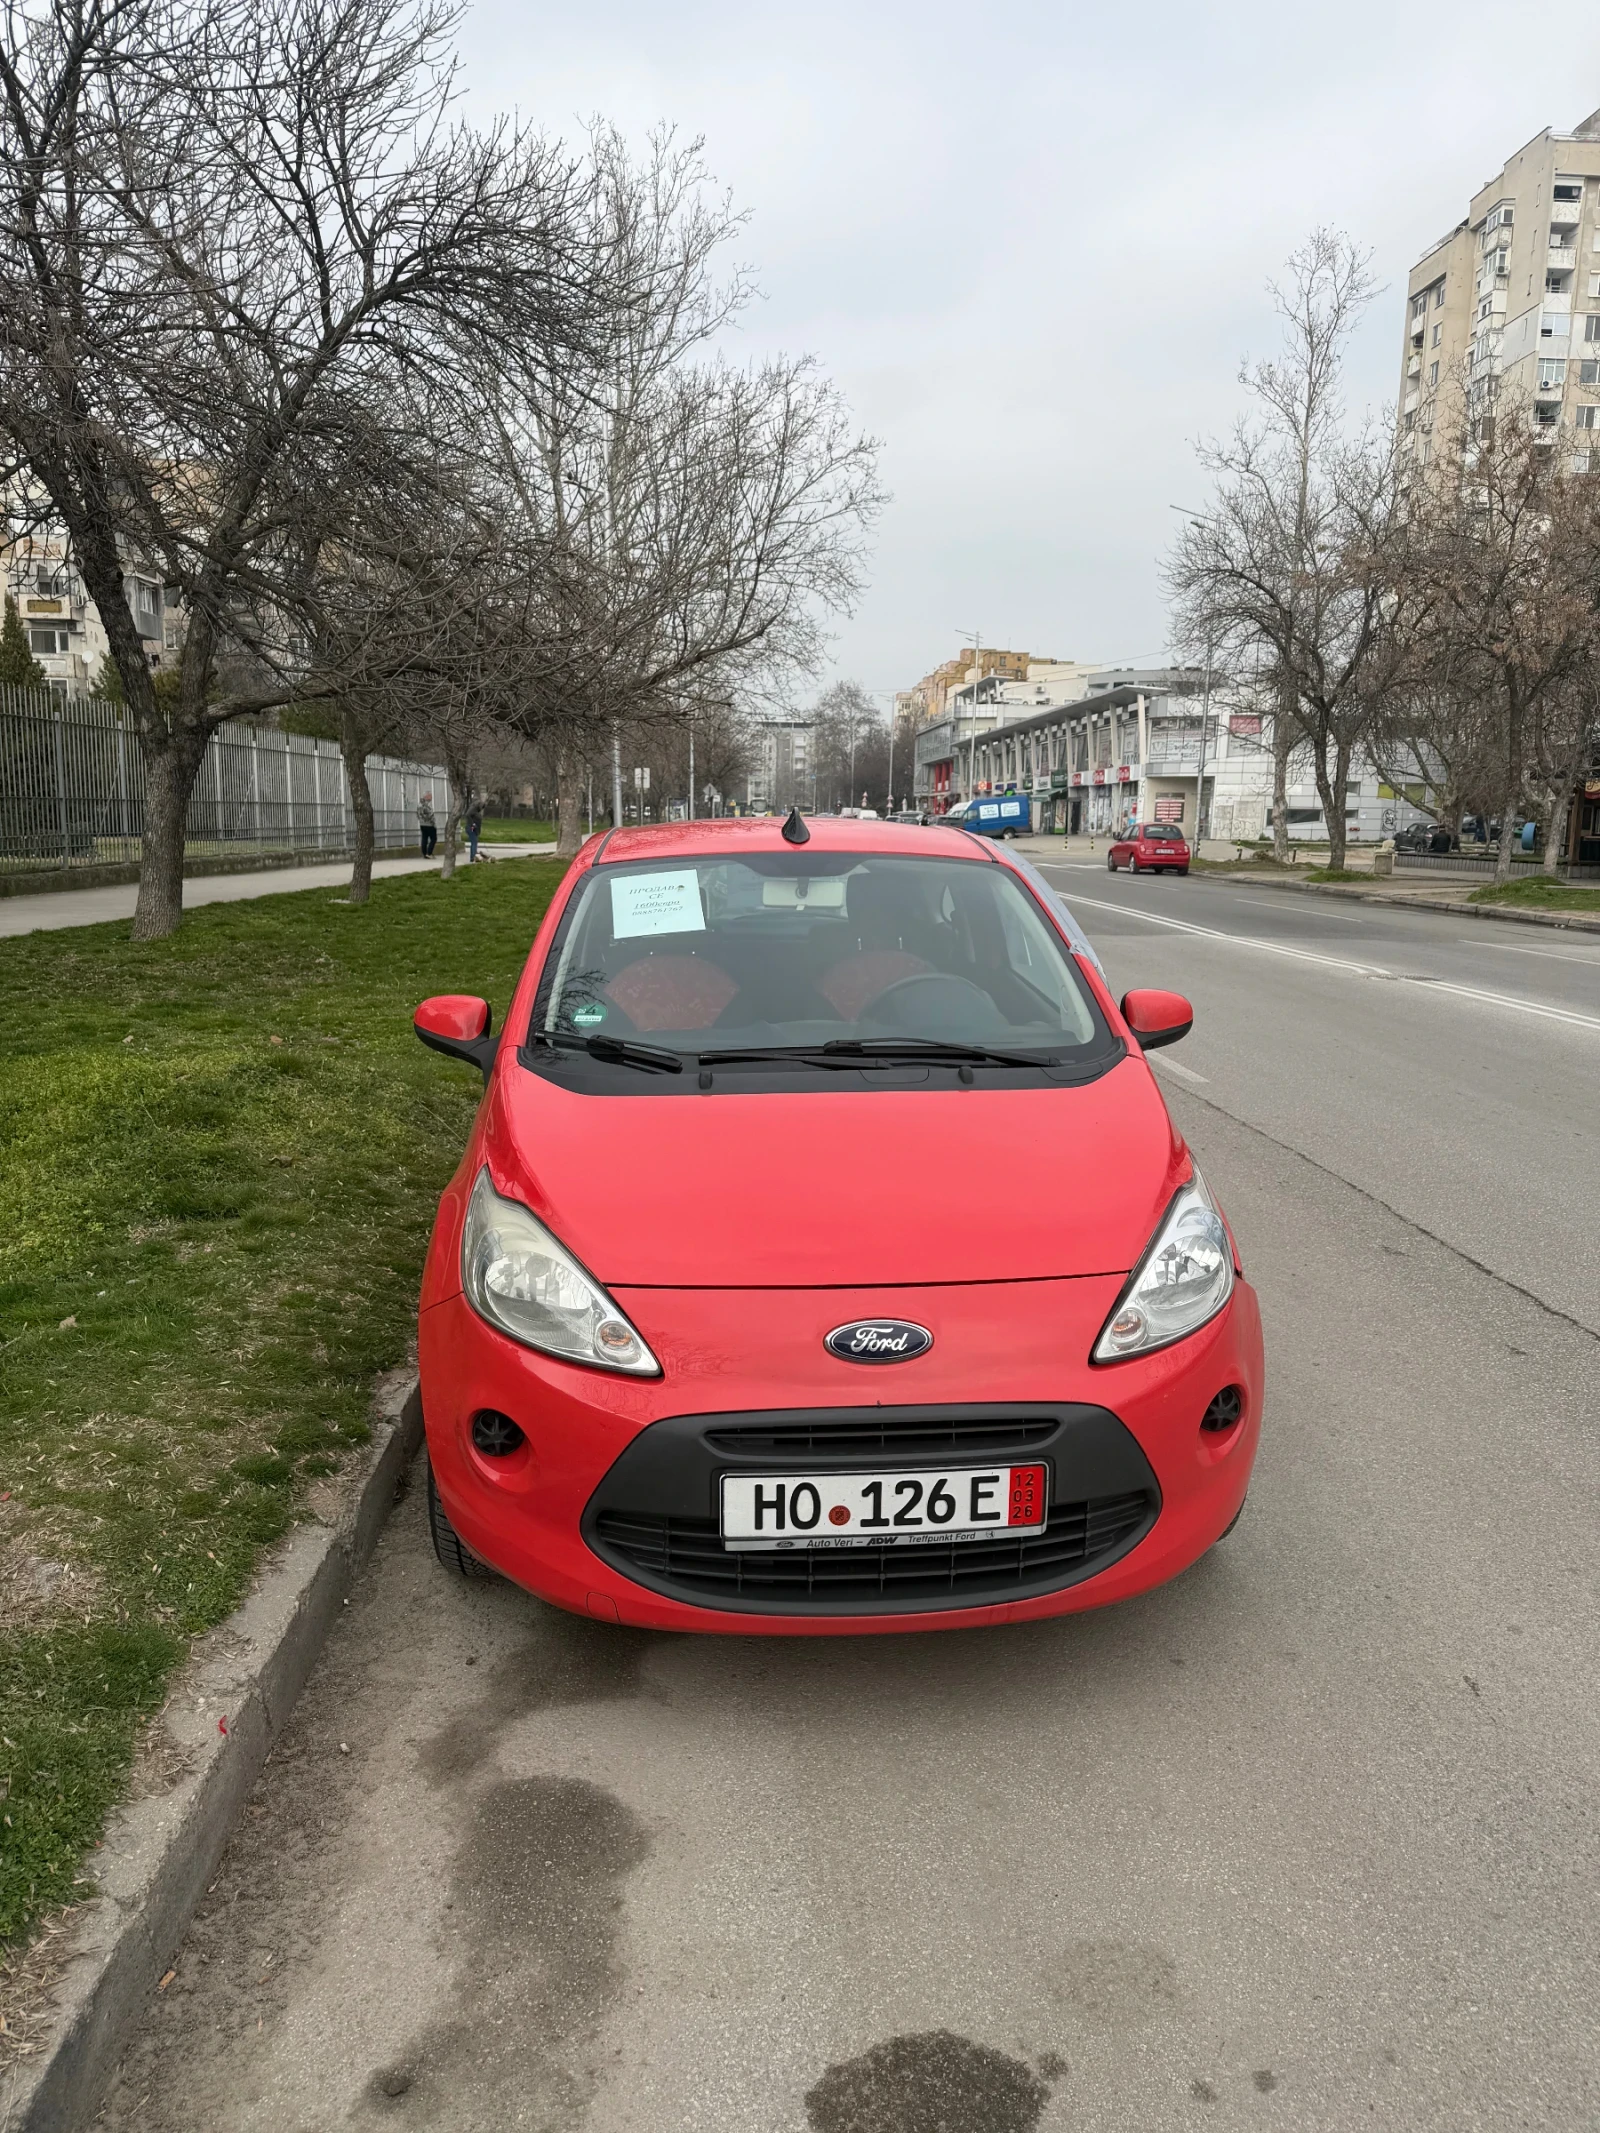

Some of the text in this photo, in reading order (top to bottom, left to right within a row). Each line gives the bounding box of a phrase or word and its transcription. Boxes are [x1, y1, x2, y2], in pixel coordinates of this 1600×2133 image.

[649, 892, 664, 900] СЕ
[850, 1327, 909, 1352] Ford
[1015, 1472, 1034, 1487] 12
[754, 1475, 1001, 1530] HO 126 E
[1013, 1488, 1034, 1502] 03
[1012, 1504, 1033, 1519] 26
[806, 1540, 831, 1548] Auto
[834, 1538, 853, 1547] Veri
[908, 1534, 953, 1543] Treffpunkt
[955, 1532, 976, 1540] Ford
